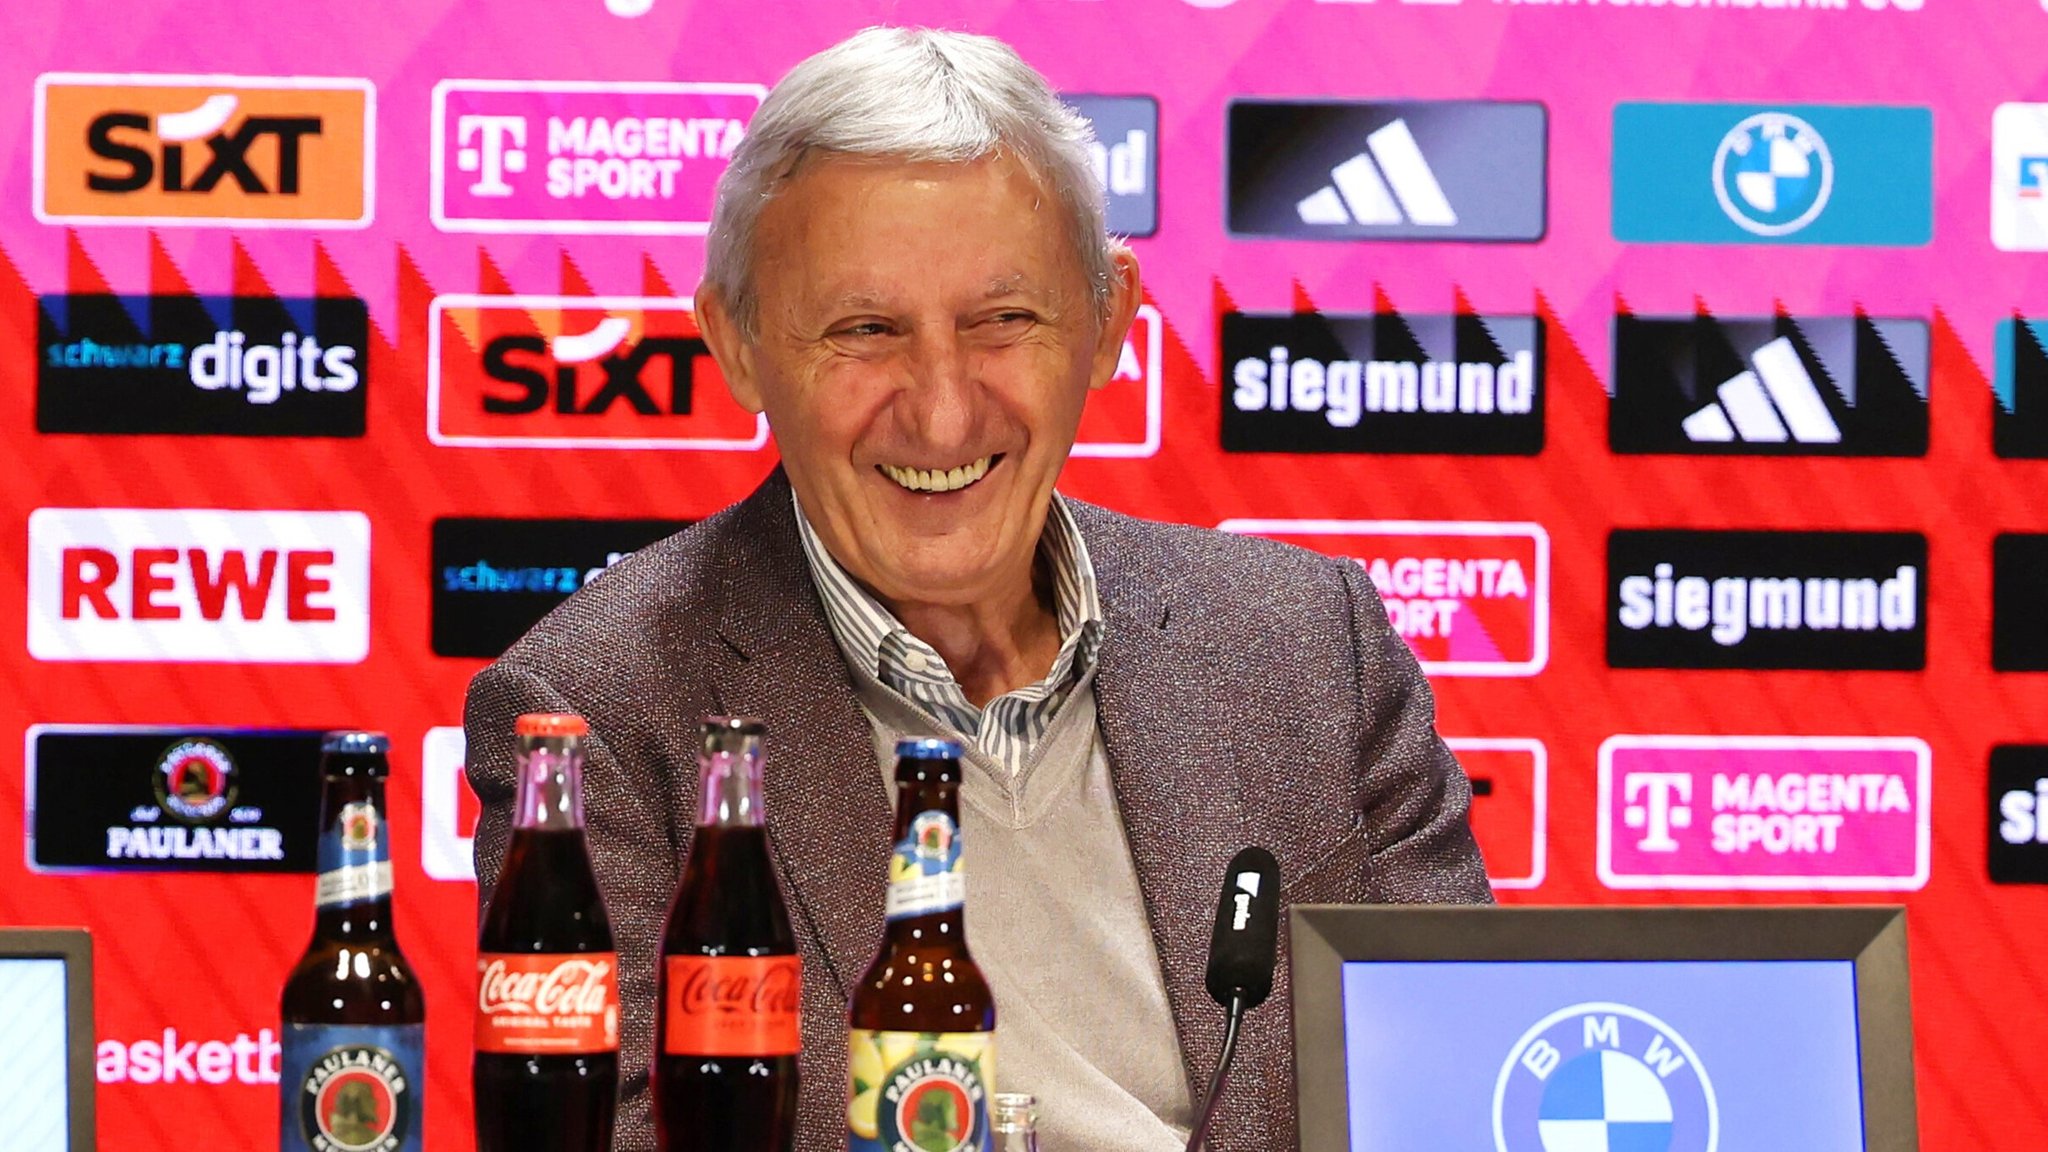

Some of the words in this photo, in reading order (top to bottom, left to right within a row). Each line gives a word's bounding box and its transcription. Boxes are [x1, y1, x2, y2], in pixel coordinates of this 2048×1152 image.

[547, 116, 746, 158] MAGENTA
[546, 157, 682, 198] SPORT
[47, 338, 184, 368] schwarz
[189, 330, 359, 404] digits
[1233, 346, 1533, 428] siegmund
[61, 547, 336, 621] REWE
[443, 558, 577, 592] schwarz
[1354, 557, 1528, 598] AGENTA
[1381, 598, 1460, 640] ORT
[1619, 563, 1917, 646] siegmund
[1711, 773, 1911, 813] MAGENTA
[107, 826, 285, 860] PAULANER
[1711, 813, 1844, 853] SPORT
[479, 959, 610, 1015] Coca-Cola
[1521, 1016, 1685, 1080] BMW
[305, 1050, 406, 1096] PAULANER
[885, 1058, 983, 1103] PAULANER
